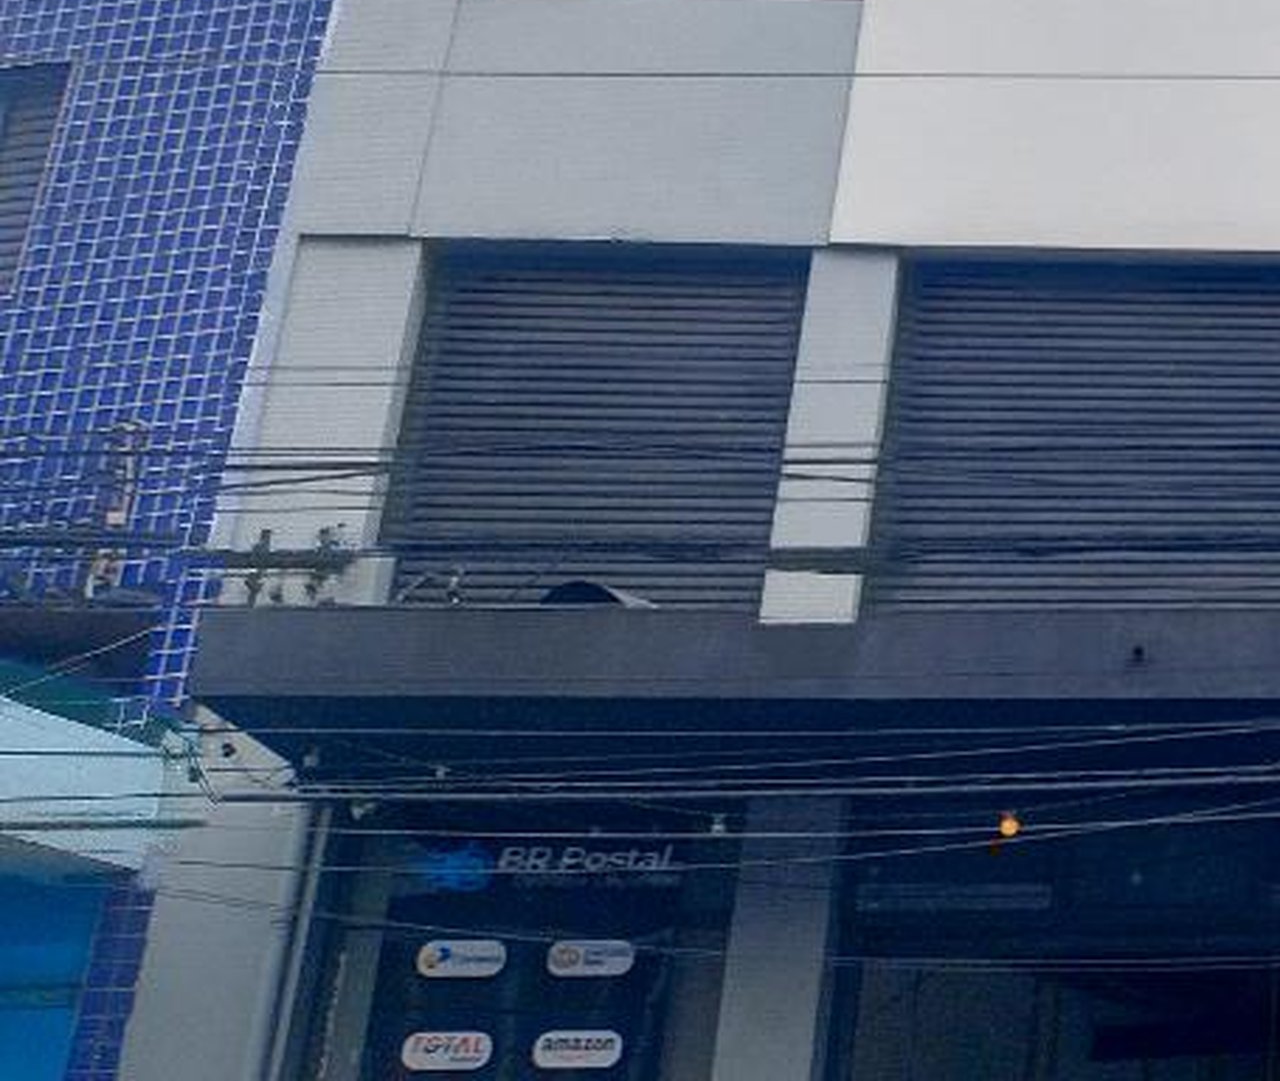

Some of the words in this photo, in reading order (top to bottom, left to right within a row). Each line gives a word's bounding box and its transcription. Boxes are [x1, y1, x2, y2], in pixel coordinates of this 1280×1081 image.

[499, 846, 553, 871] BR
[560, 843, 674, 871] Postal
[412, 1035, 485, 1055] TOTAL
[541, 1037, 617, 1051] amazon
